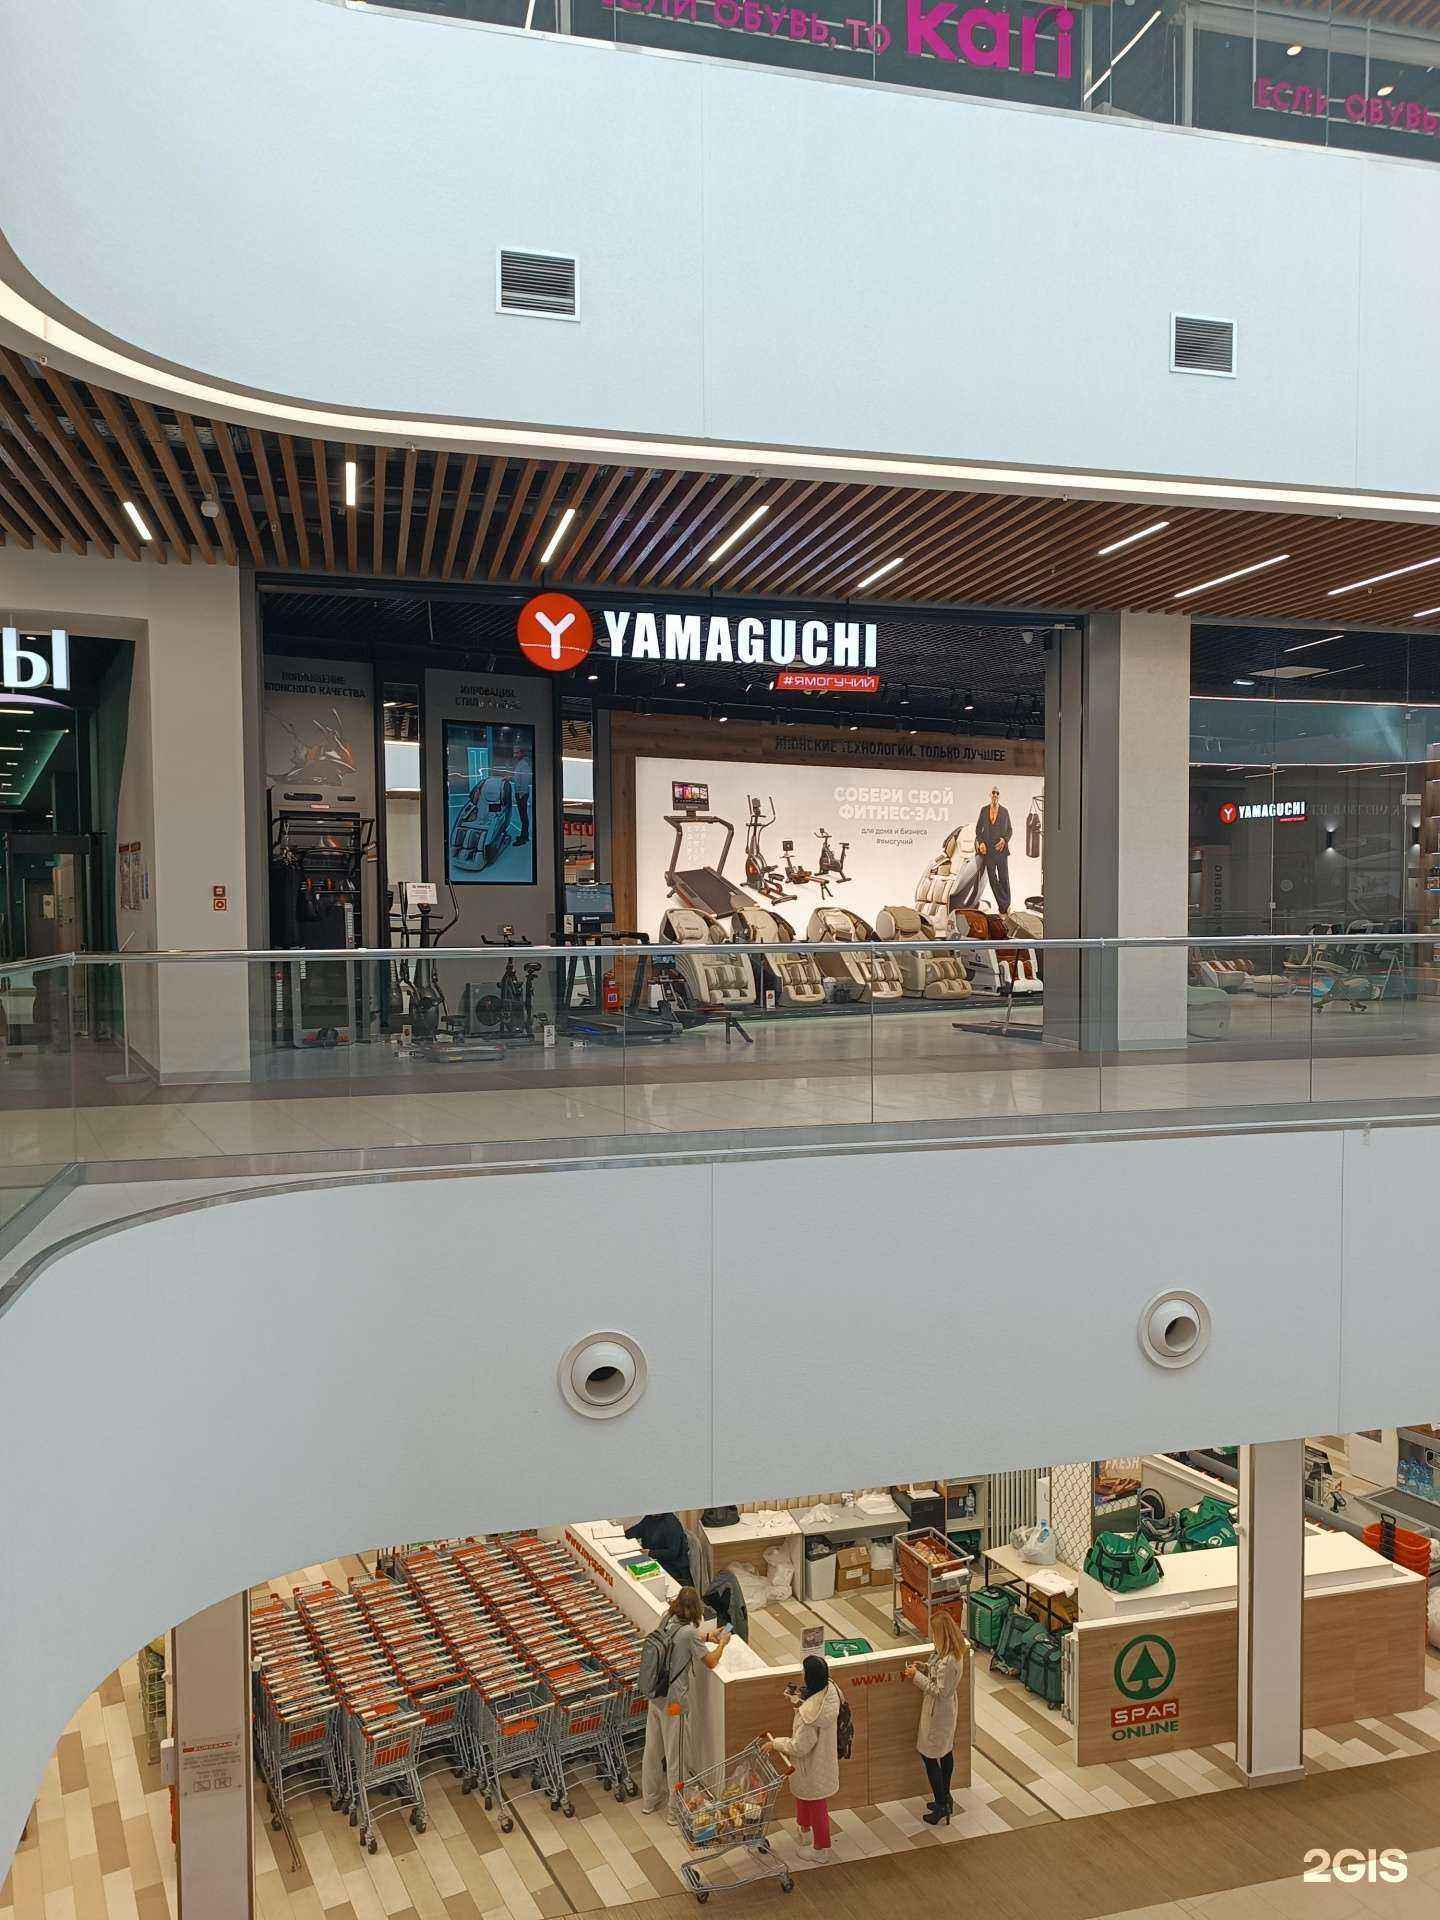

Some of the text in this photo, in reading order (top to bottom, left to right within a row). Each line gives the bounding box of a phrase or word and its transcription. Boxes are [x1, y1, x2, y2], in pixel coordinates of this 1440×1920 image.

[845, 18, 891, 54] ТО
[907, 0, 1073, 80] kari
[534, 610, 877, 667] Y YAMAGUCHI
[783, 675, 876, 689] #ЯМОГУЧИЙ
[919, 744, 961, 759] ТОЛЬКО
[963, 747, 1007, 762] ЛУЧШЕЕ
[834, 786, 953, 805] СОБЕРИ СВОЙ
[838, 803, 949, 821] ФИТНЕС-ЗАЛ
[1239, 801, 1306, 819] YAMAGUCHI
[1114, 1702, 1177, 1724] SPAR
[1112, 1720, 1179, 1741] ONLINE
